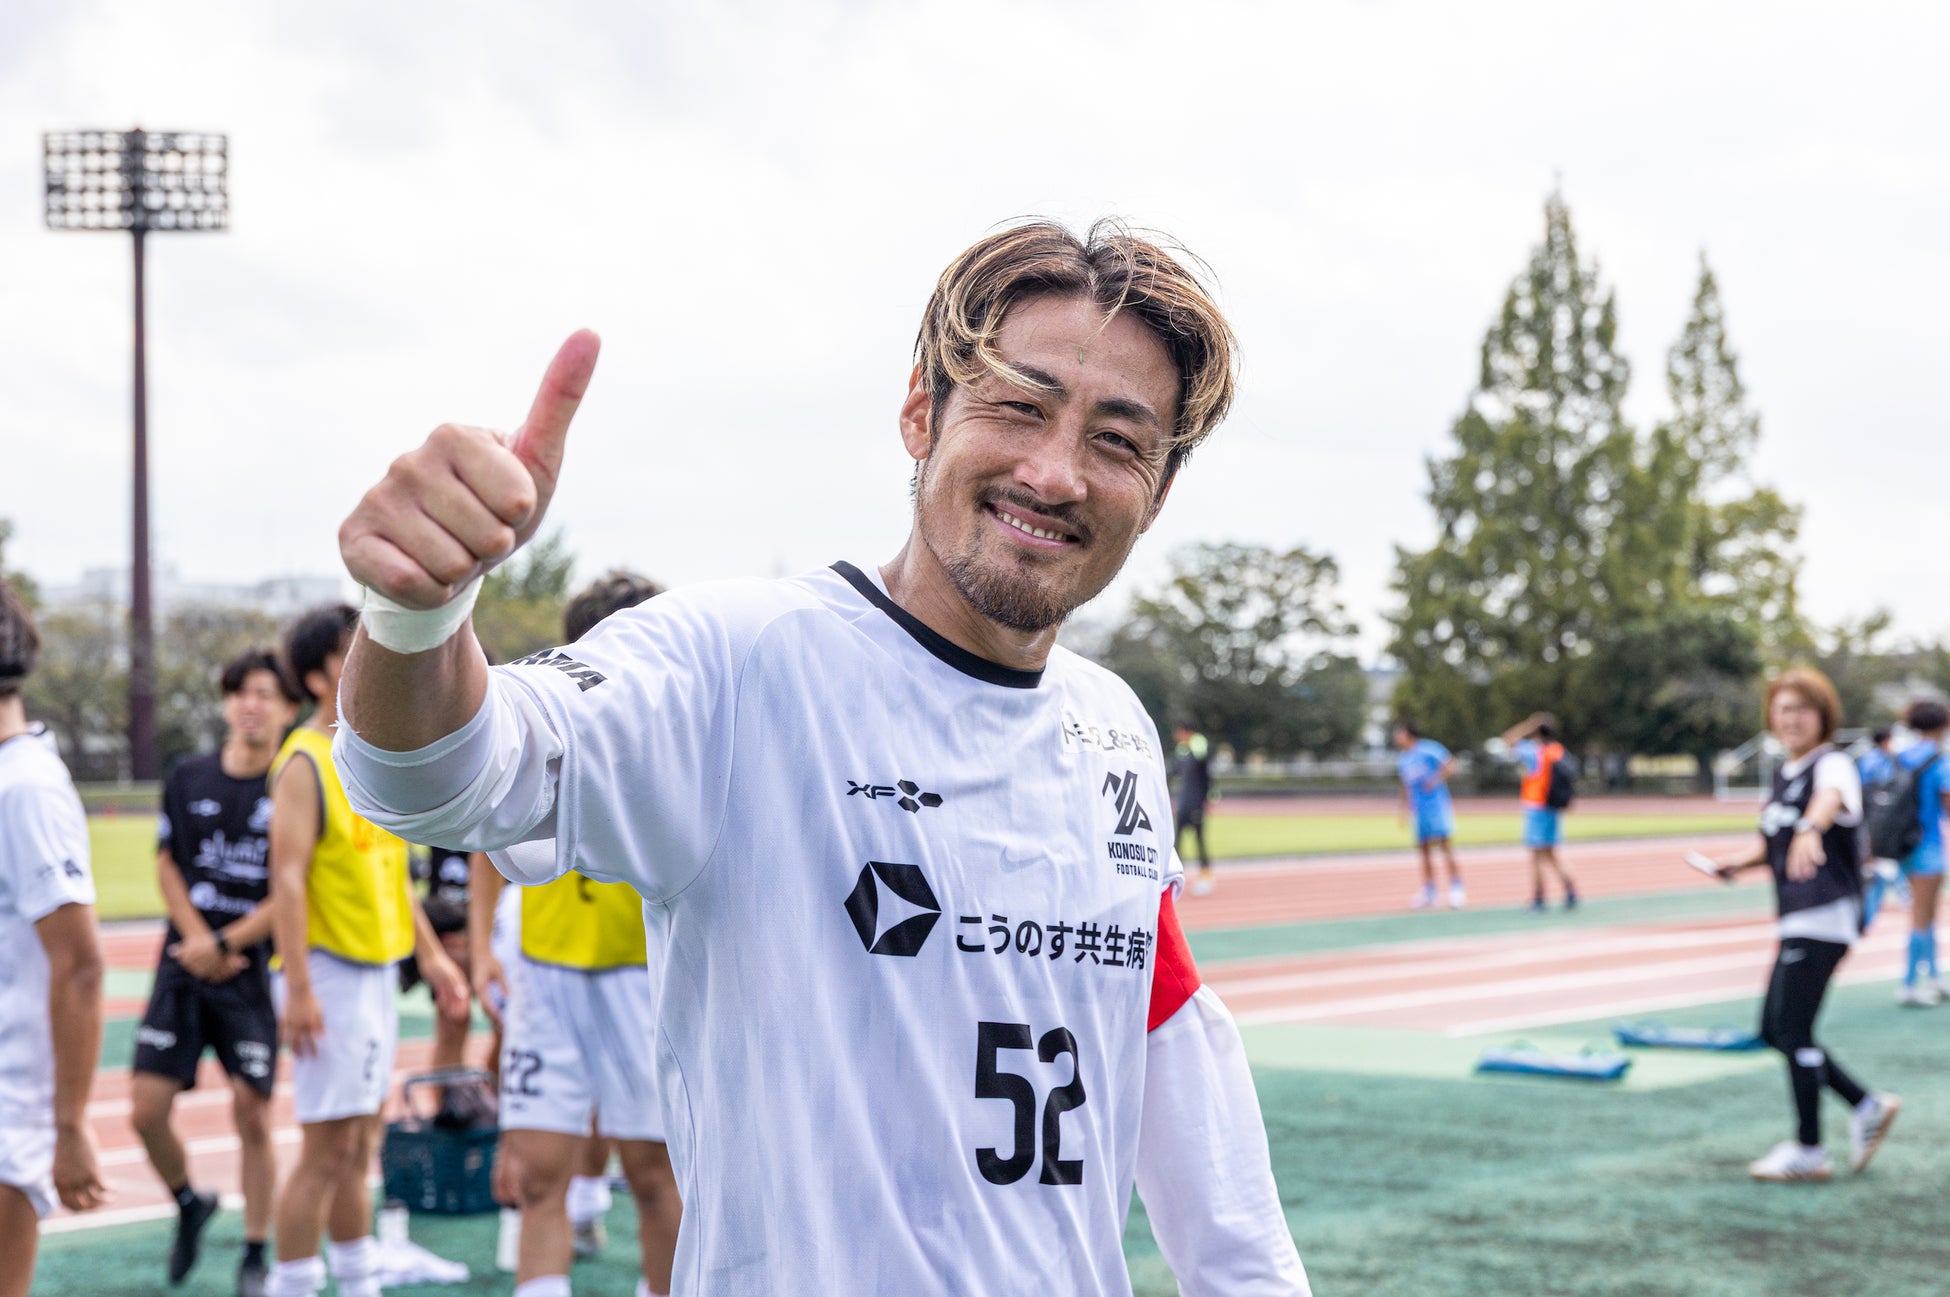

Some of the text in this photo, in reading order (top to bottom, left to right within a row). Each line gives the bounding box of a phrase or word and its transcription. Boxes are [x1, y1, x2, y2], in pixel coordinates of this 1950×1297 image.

[1107, 841, 1146, 862] KONOSU
[1116, 863, 1147, 878] FOOTBALL
[975, 1021, 1086, 1185] 52
